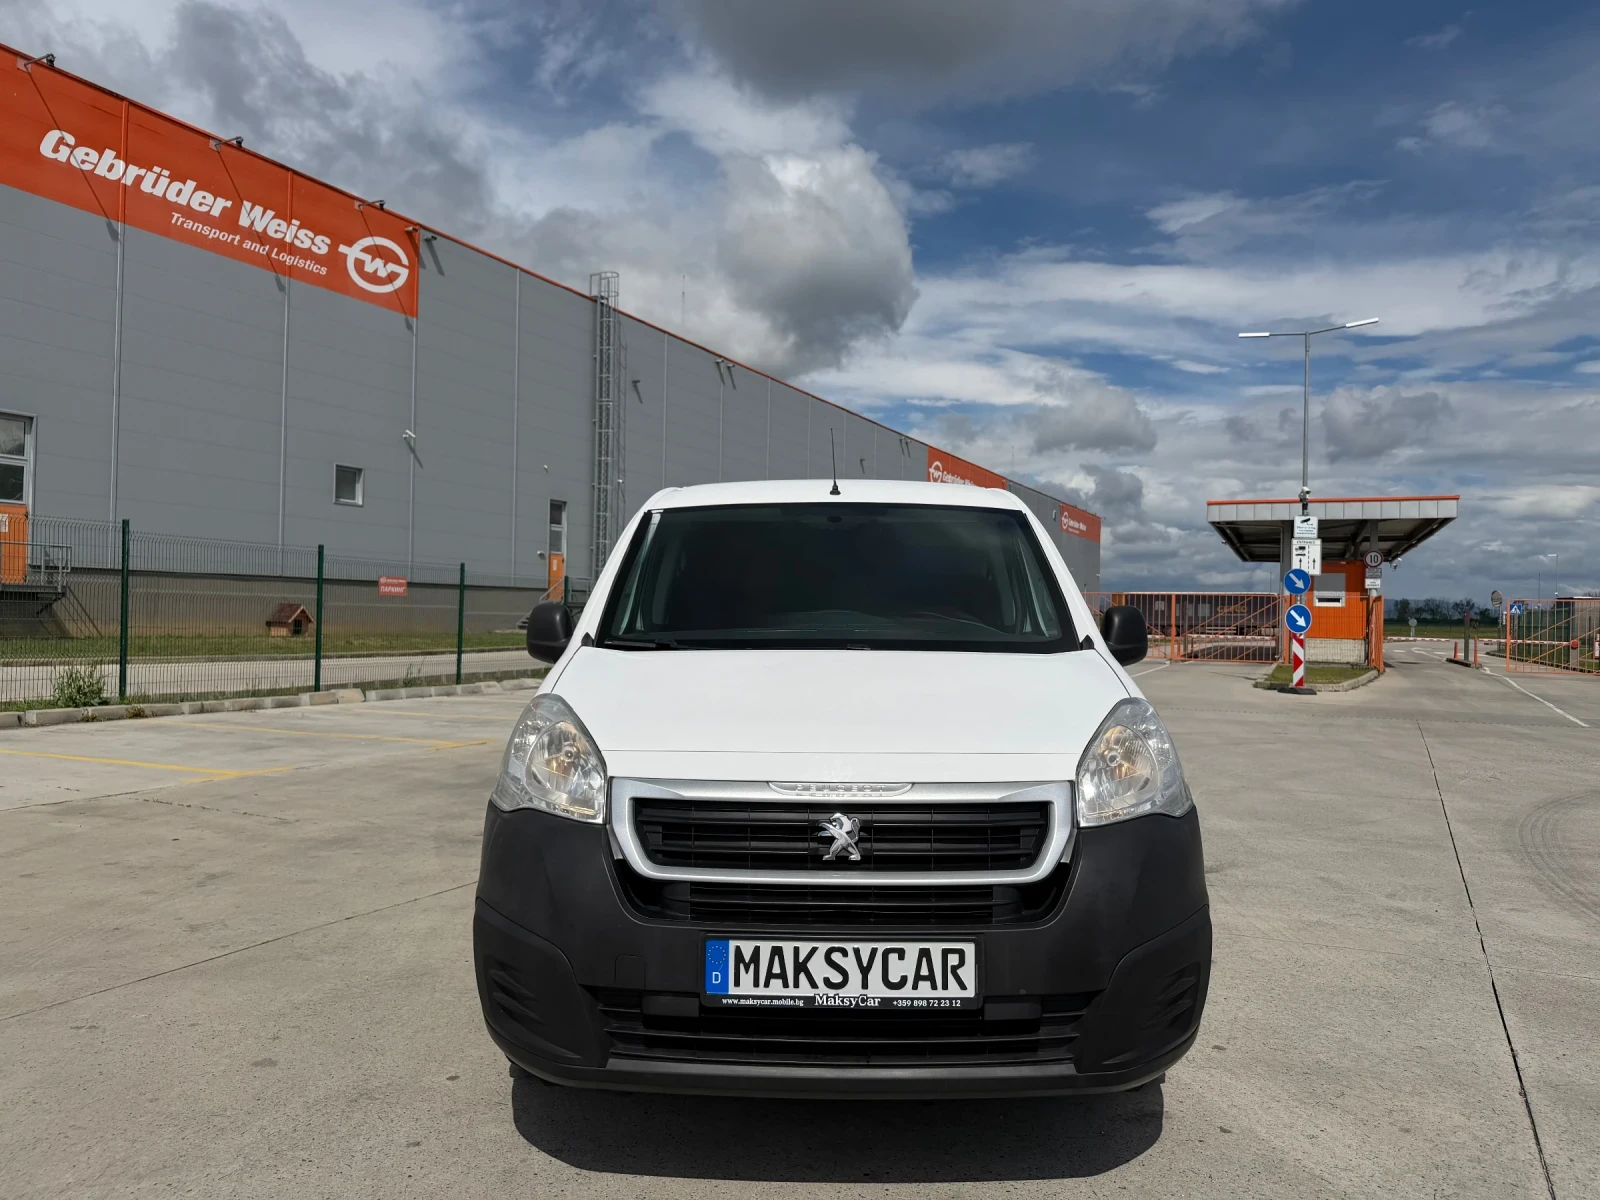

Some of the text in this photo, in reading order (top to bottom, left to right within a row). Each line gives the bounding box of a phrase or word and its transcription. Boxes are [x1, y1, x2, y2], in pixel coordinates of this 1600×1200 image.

[39, 129, 331, 255] Gebrüder Weiss
[171, 212, 328, 276] Transport and Logistics
[1370, 554, 1378, 564] 10
[796, 784, 886, 792] PEUGEOT
[734, 945, 967, 990] MAKSYCAR
[711, 971, 721, 984] D
[722, 998, 804, 1007] www.maksycar.mobile.bg
[814, 994, 881, 1008] MaksyCar
